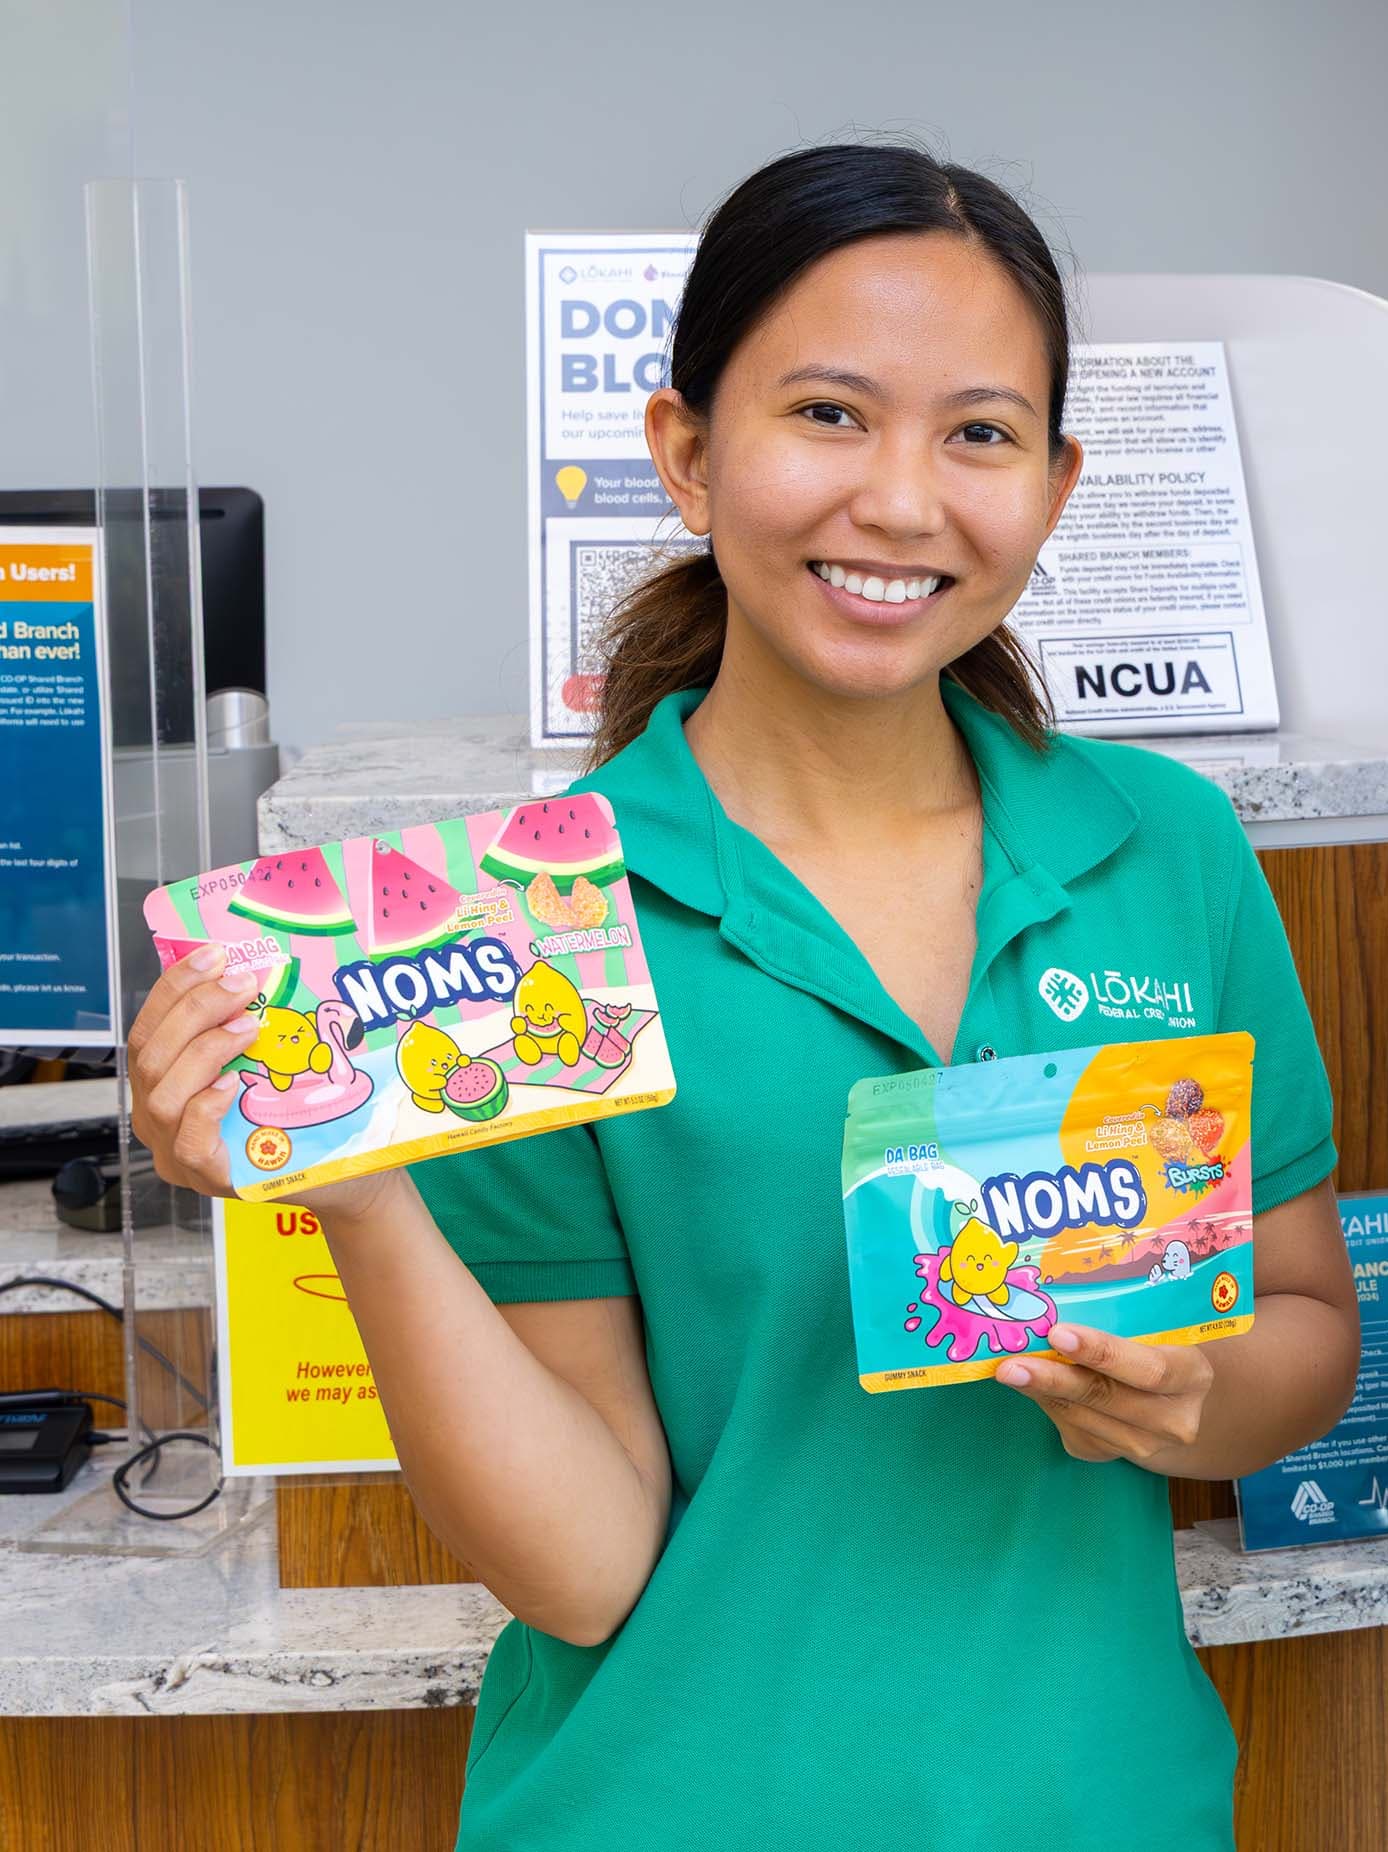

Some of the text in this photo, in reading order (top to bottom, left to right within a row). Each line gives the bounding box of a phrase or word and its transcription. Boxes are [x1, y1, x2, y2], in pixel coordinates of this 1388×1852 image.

[561, 299, 674, 339] DON
[1070, 355, 1195, 368] FORMATION ABOUT THE
[561, 352, 672, 393] BLO
[1081, 367, 1216, 379] OPENING A NEW ACCOUNT
[562, 408, 645, 422] Help save liv
[562, 428, 643, 440] our upcomin
[595, 476, 659, 488] Your blood
[1079, 472, 1206, 486] VAILABILITY POLICY
[594, 492, 629, 503] blood
[1058, 551, 1098, 561] SHARED
[1100, 550, 1140, 560] BRANCH
[10, 563, 76, 581] Users!
[1030, 577, 1056, 585] O-OP
[14, 620, 80, 639] Branch
[34, 642, 81, 660] ever!
[1074, 660, 1213, 699] NCUA
[456, 899, 509, 918] Li Hing &
[447, 911, 514, 933] Lemon Peel
[242, 937, 280, 958] BAG
[538, 925, 631, 956] WATERMELON
[341, 944, 516, 1023] NOMS
[1098, 1004, 1140, 1019] FEDERAL
[469, 1126, 489, 1138] Candy
[489, 1120, 514, 1134] Factory
[1097, 1121, 1144, 1137] Li Hing &
[1087, 1133, 1146, 1151] Lemon Peel
[886, 1144, 938, 1164] DA BAG
[1168, 1163, 1223, 1188] BURSTS
[988, 1167, 1140, 1237] NOMS
[276, 1211, 324, 1236] US
[1340, 1213, 1388, 1237] AHI
[884, 1369, 927, 1381] GUMMY SNACK
[286, 1384, 377, 1404] we may as
[1311, 1440, 1329, 1450] differ
[1338, 1439, 1352, 1449] you
[1353, 1437, 1366, 1445] use
[1367, 1434, 1388, 1444] other
[1282, 1463, 1308, 1473] limited
[1309, 1462, 1317, 1471] to
[1318, 1459, 1344, 1470] $1,000
[1345, 1457, 1358, 1468] per
[1285, 1453, 1312, 1463] Shared
[1313, 1450, 1339, 1460] Branch
[1303, 1502, 1334, 1514] CO-OP
